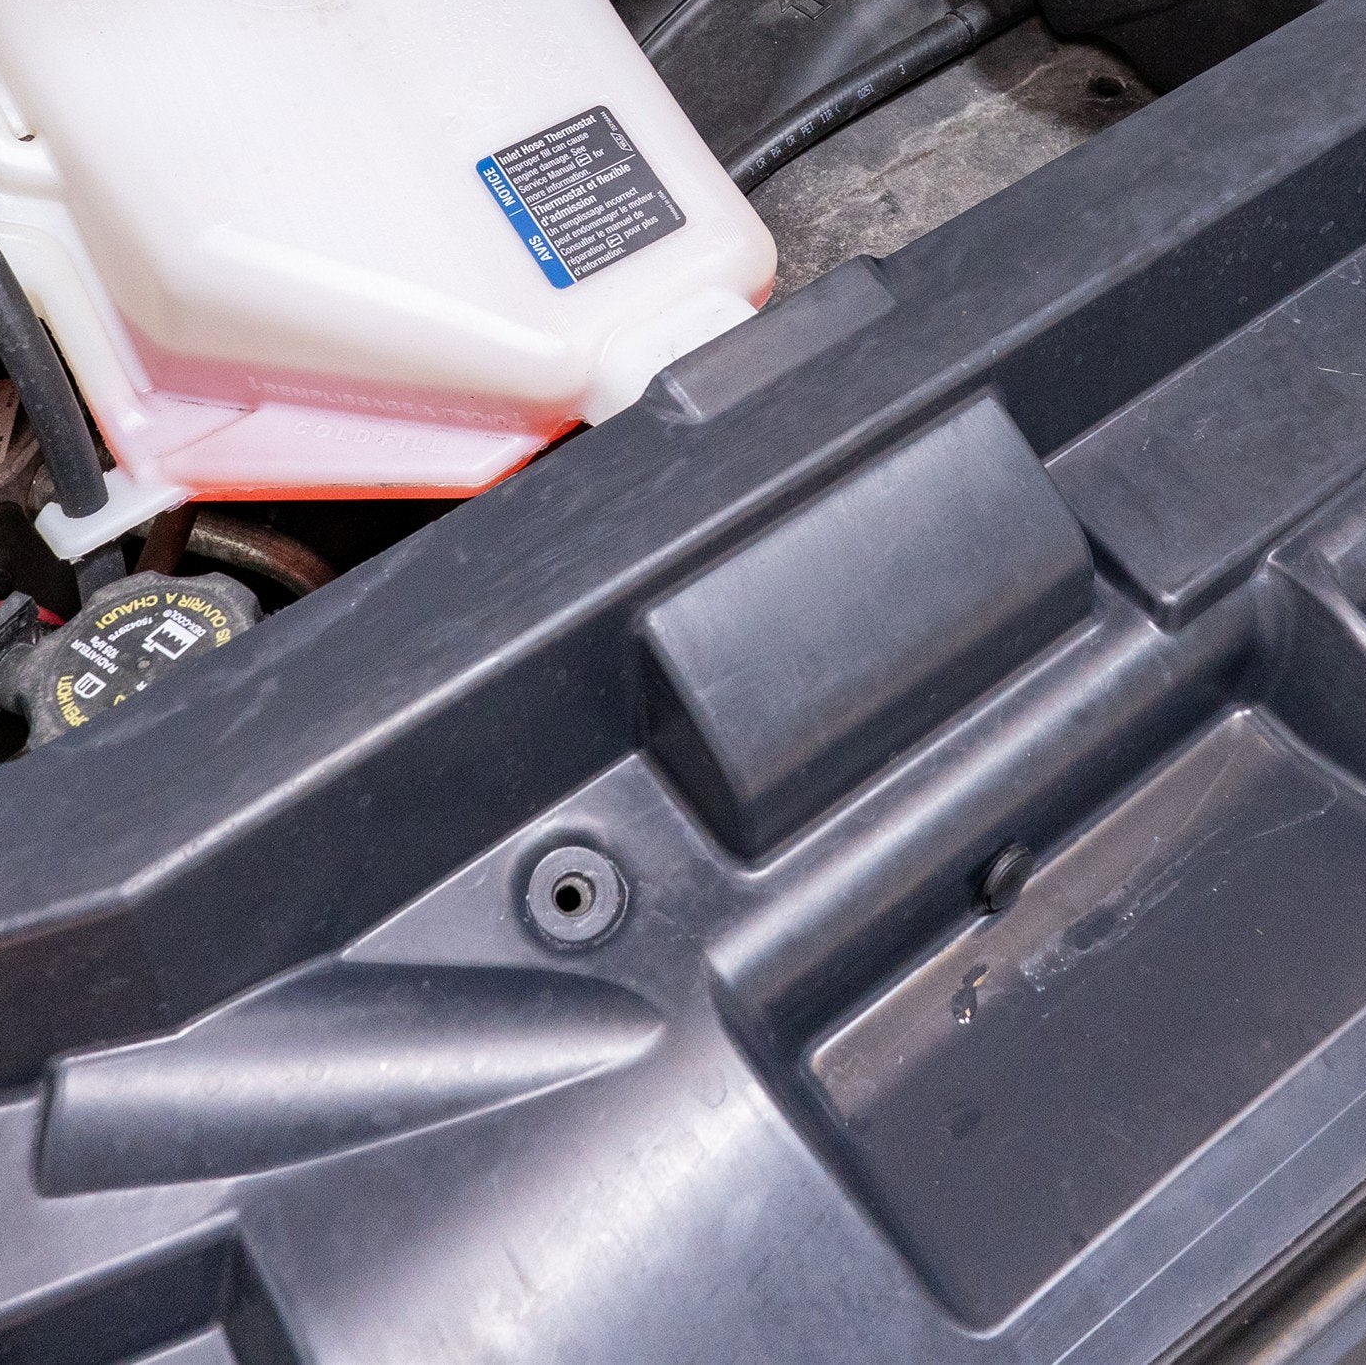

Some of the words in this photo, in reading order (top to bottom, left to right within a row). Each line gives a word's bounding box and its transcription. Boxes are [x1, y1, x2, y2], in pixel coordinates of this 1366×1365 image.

[498, 148, 522, 165] Inlet
[519, 139, 545, 155] Hose
[543, 114, 597, 143] Thermostat
[799, 121, 814, 137] PET
[504, 154, 540, 175] Improper
[539, 148, 552, 158] fill
[551, 142, 567, 153] can
[566, 132, 589, 146] cause
[512, 167, 539, 184] engine
[538, 153, 572, 171] damage.
[570, 145, 587, 156] See
[517, 176, 548, 194] Service
[546, 161, 576, 180] Manual
[592, 148, 604, 158] for
[482, 166, 516, 207] NOTICE
[524, 189, 546, 204] more
[544, 168, 591, 193] information.
[531, 184, 587, 216] Thermostat
[586, 179, 598, 190] et
[595, 164, 631, 185] flexible
[540, 194, 597, 227] d'admission
[546, 227, 560, 236] Un
[558, 204, 605, 231] remplissage
[603, 186, 639, 208] incorrect
[553, 233, 572, 248] peut
[571, 209, 619, 238] endommager
[618, 205, 628, 214] le
[627, 191, 656, 209] moteur.
[528, 235, 553, 261] AVIS
[559, 234, 596, 256] Consulter
[595, 230, 605, 238] le
[604, 214, 633, 234] manuel
[632, 210, 644, 220] de
[566, 242, 606, 267] réparation
[623, 224, 641, 239] pour
[640, 215, 659, 230] plus
[573, 246, 626, 276] d'information.
[292, 421, 371, 445] COLD
[378, 431, 443, 455] FILL
[177, 593, 227, 628] OUVRIR
[70, 639, 119, 675] RADIATEUR
